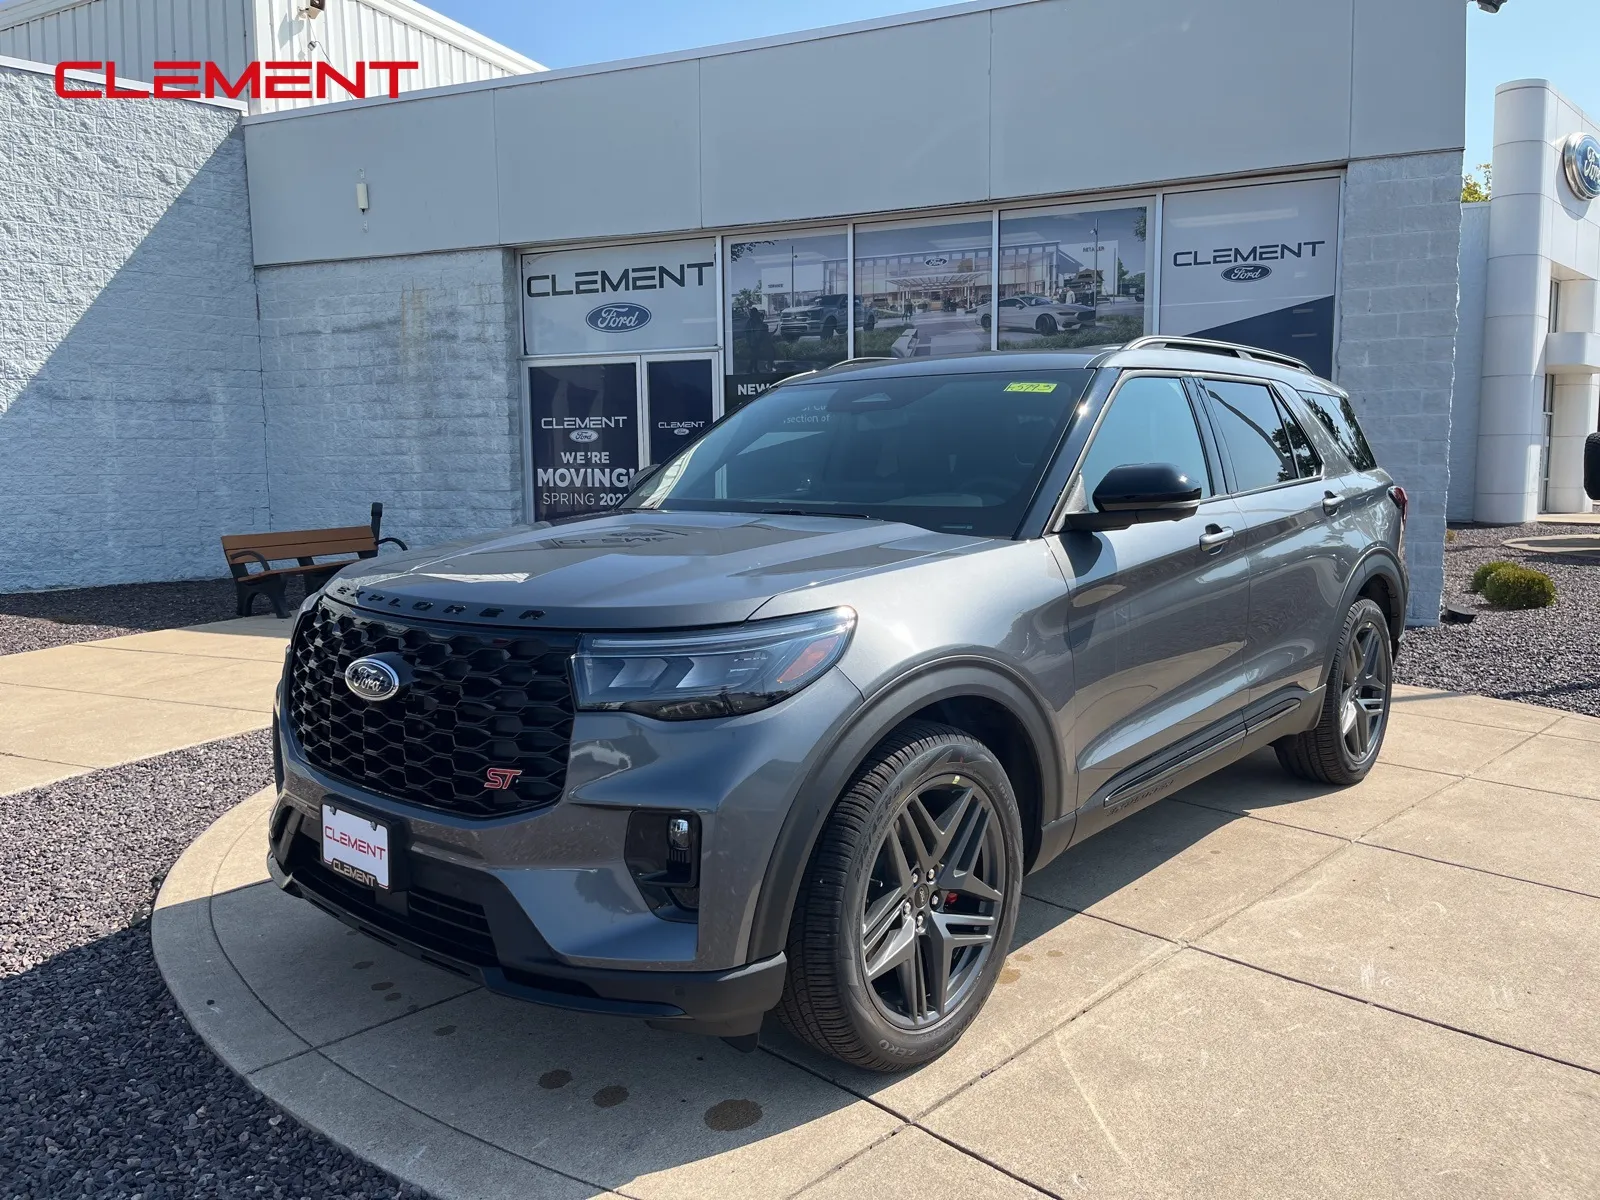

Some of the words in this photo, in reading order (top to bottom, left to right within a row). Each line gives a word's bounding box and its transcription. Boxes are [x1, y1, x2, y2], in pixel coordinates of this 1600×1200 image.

[1173, 240, 1325, 267] CLEMENT
[526, 262, 714, 298] CLEMENT
[737, 383, 770, 396] NEW
[541, 416, 628, 429] CLEMENT
[657, 420, 706, 429] CLEMENT
[783, 413, 819, 424] section
[820, 413, 831, 423] of
[542, 492, 595, 505] SPRING
[599, 492, 627, 506] 202
[483, 767, 523, 790] ST
[324, 825, 386, 861] CLEMENT
[332, 859, 376, 887] CLEMENT
